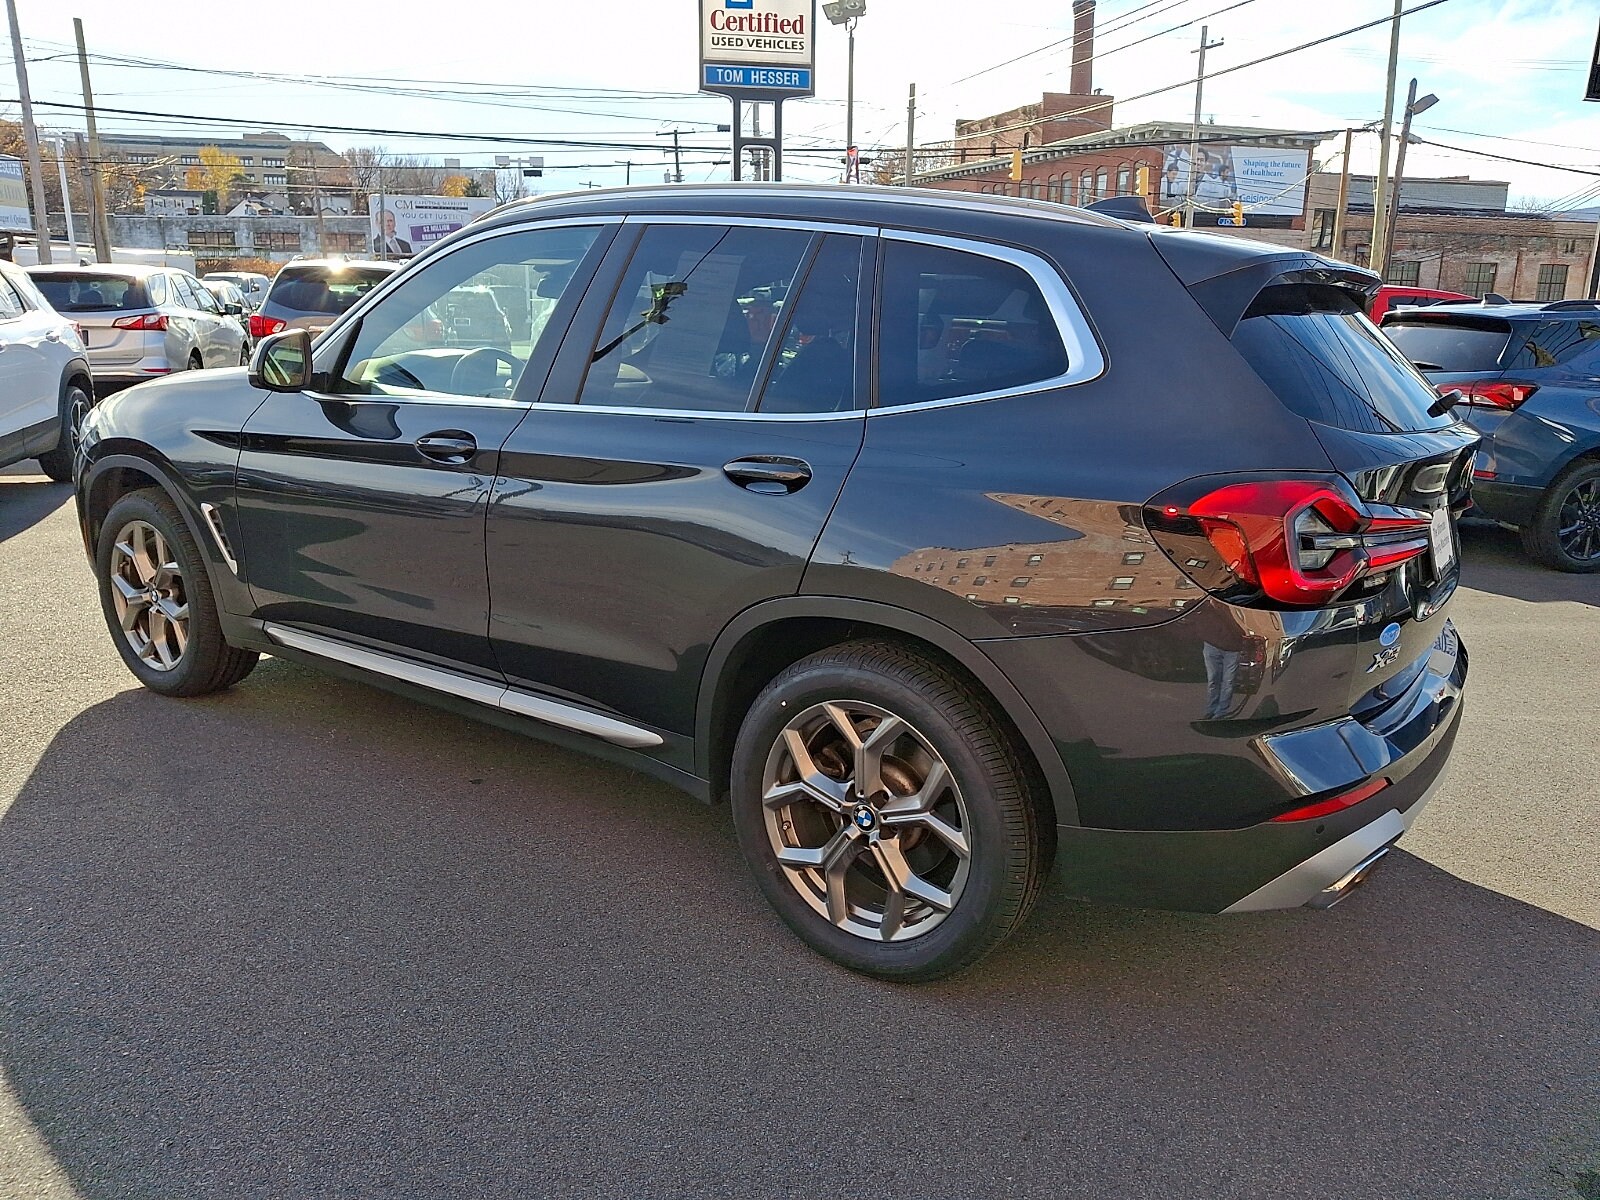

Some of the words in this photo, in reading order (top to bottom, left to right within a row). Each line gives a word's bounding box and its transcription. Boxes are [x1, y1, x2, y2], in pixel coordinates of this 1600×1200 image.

[710, 9, 805, 35] Certified
[711, 36, 744, 47] USED
[746, 38, 805, 50] VEHICLES
[716, 68, 743, 83] TOM
[751, 70, 800, 86] HESSER
[1243, 159, 1269, 169] Shaping
[1270, 160, 1281, 168] the
[1281, 160, 1302, 169] future
[1242, 168, 1250, 176] of
[1250, 168, 1285, 177] healthcare.
[394, 199, 414, 210] CM
